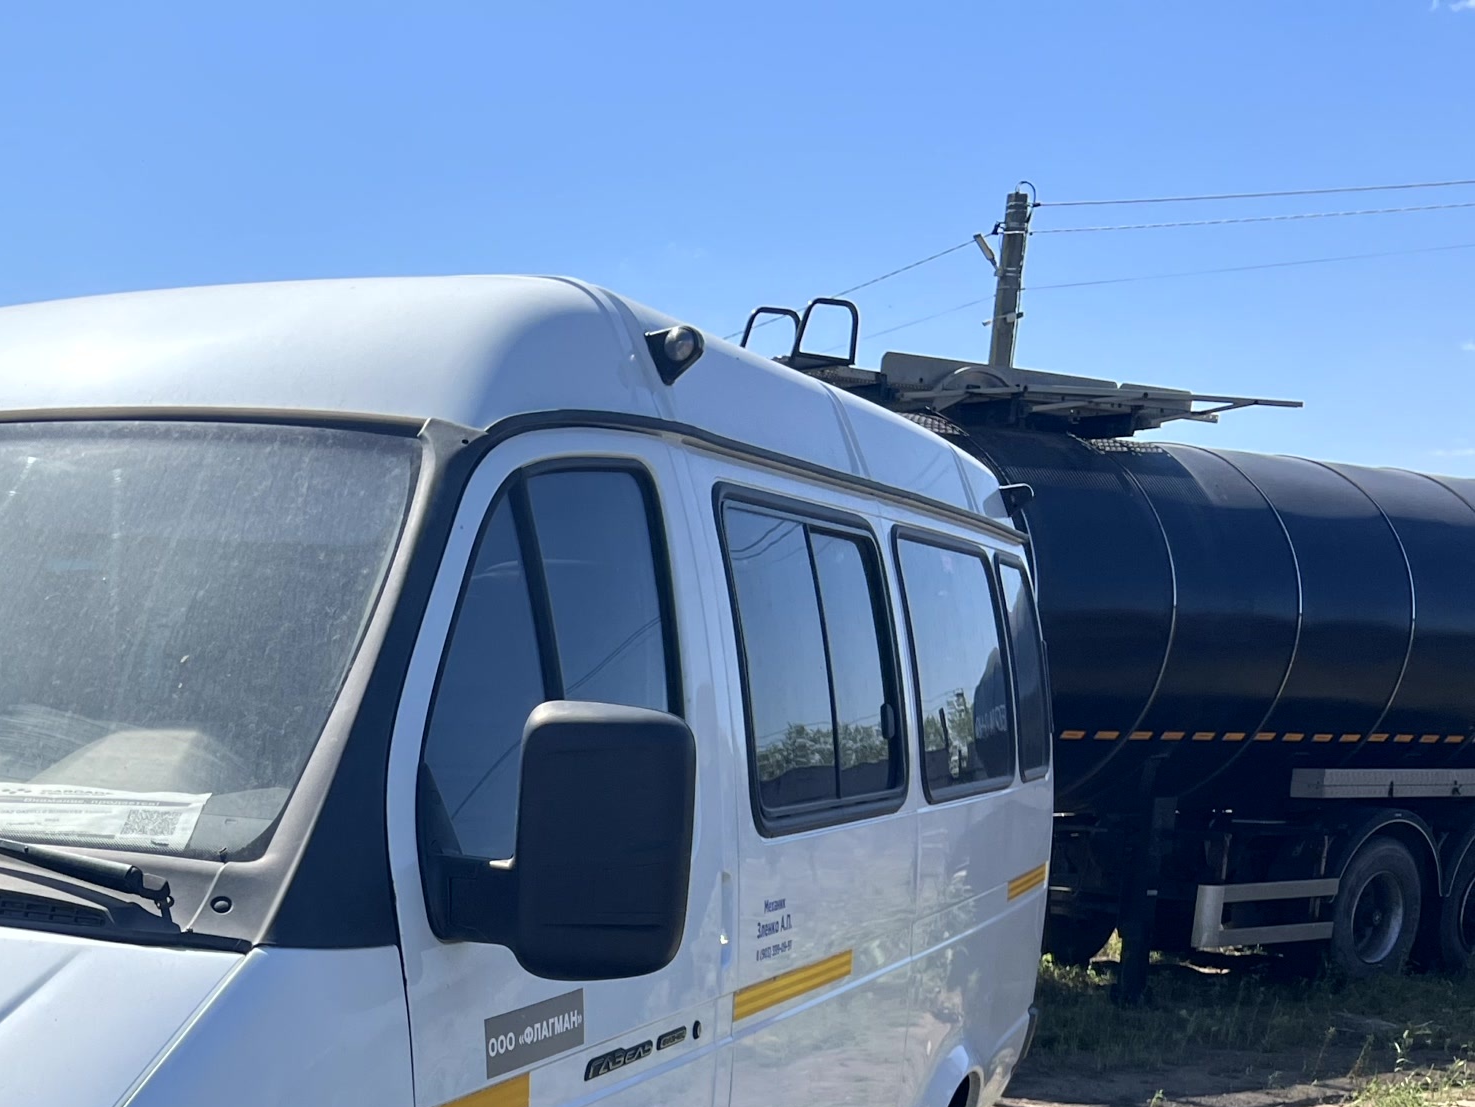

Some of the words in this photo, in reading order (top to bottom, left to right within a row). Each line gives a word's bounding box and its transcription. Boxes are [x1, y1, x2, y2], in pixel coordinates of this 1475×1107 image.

[764, 898, 786, 914] Механик
[488, 1032, 515, 1057] ООО
[518, 1009, 583, 1045] «ФЛАГМАН»
